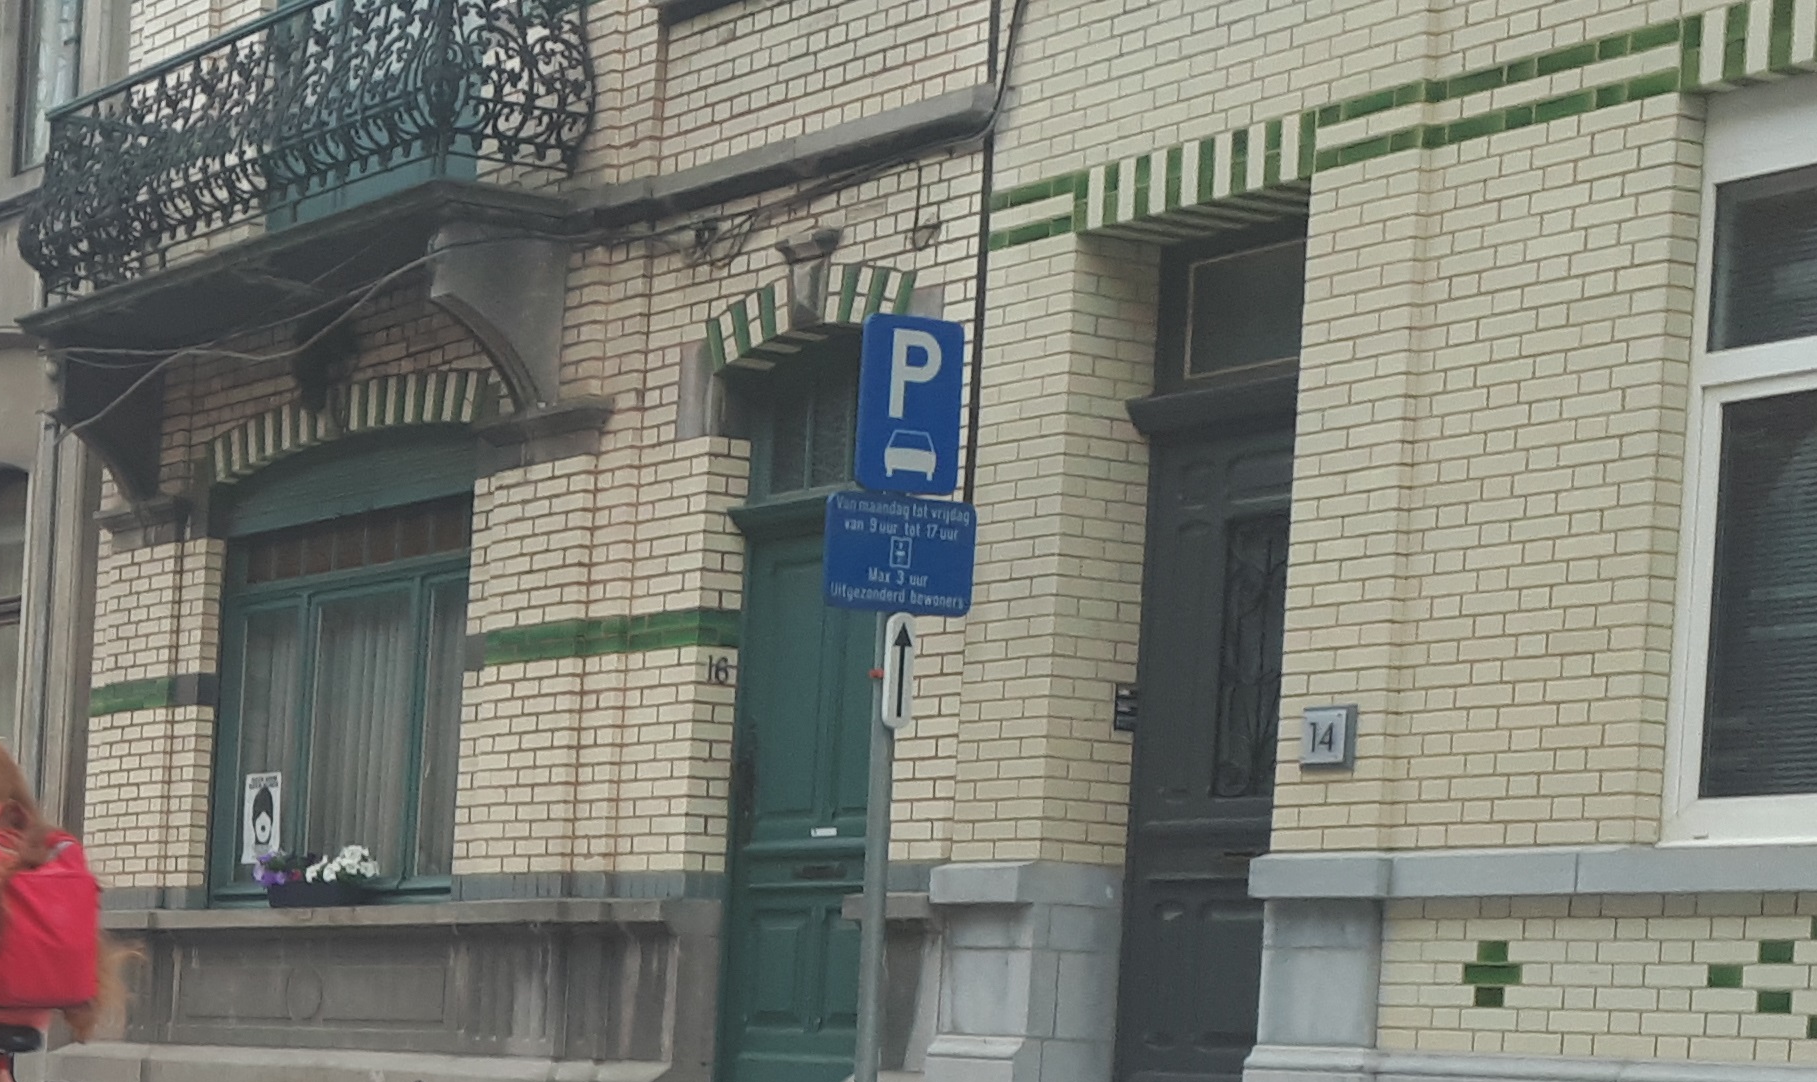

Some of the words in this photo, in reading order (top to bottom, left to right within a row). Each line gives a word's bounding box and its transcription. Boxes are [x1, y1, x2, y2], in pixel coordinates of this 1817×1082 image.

[888, 327, 942, 420] P
[836, 495, 856, 509] Van
[858, 499, 910, 519] maandag
[912, 503, 928, 518] tot
[931, 508, 970, 526] vrijdag
[845, 519, 864, 531] van
[879, 523, 898, 535] uur
[904, 522, 921, 537] tot
[926, 523, 938, 539] 17
[939, 528, 959, 541] uur
[868, 566, 890, 583] Max
[896, 570, 904, 585] 3
[909, 574, 928, 587] uur
[830, 581, 905, 602] Uitgezonderd
[910, 590, 964, 609] bewoners
[707, 655, 729, 684] 16
[1309, 721, 1334, 752] 14
